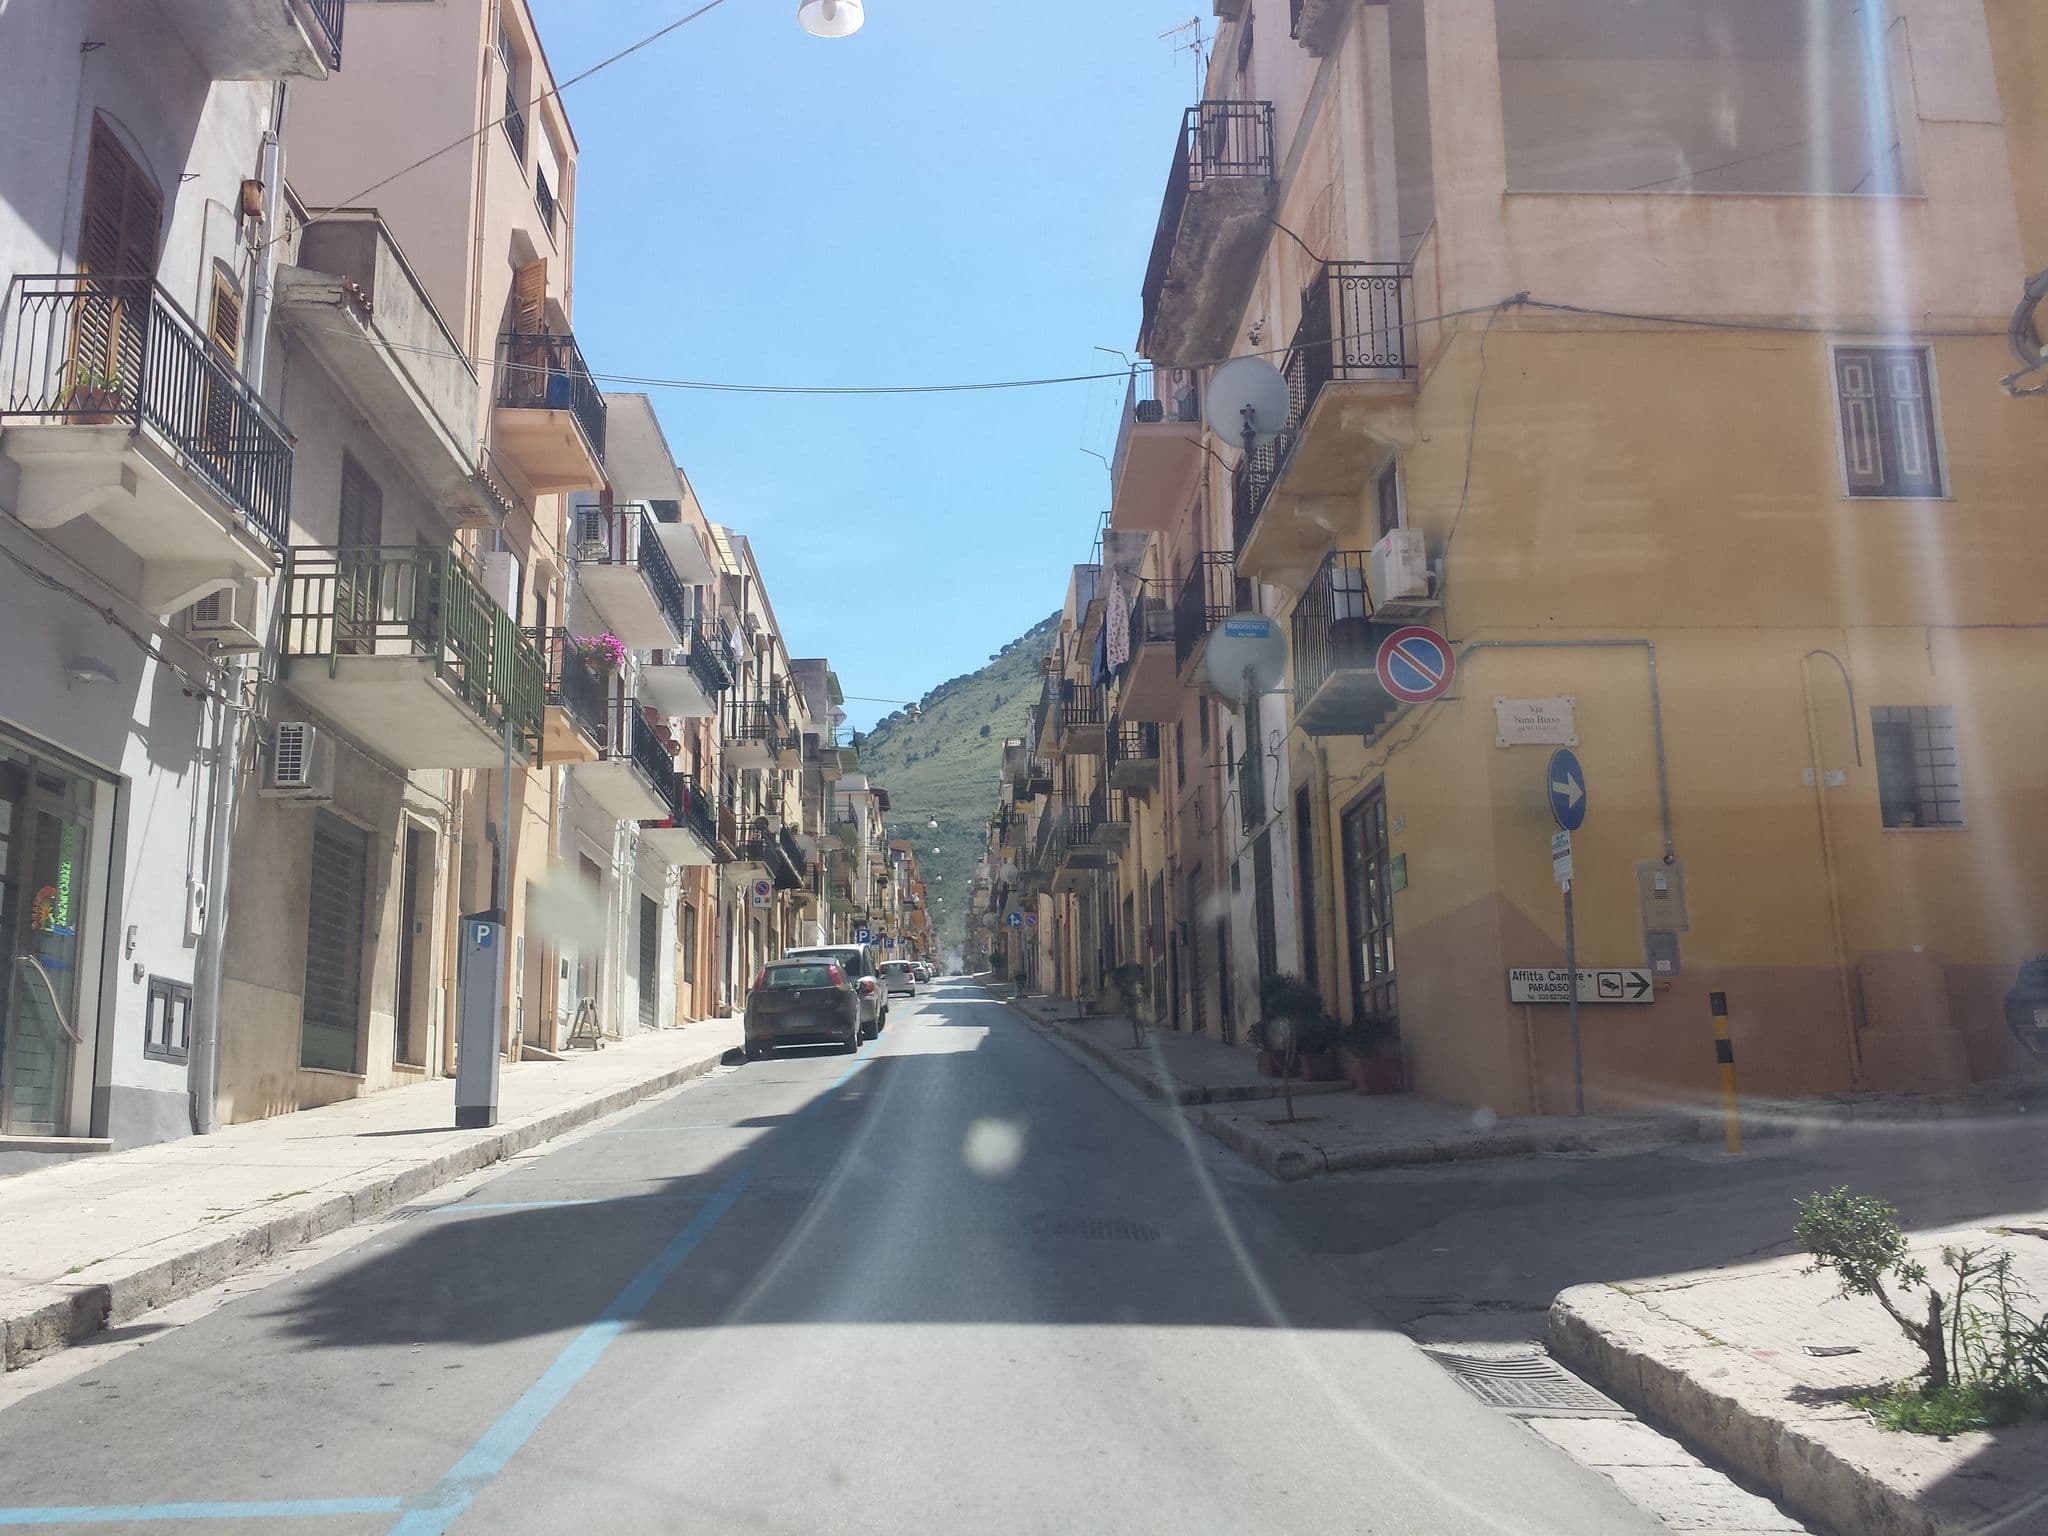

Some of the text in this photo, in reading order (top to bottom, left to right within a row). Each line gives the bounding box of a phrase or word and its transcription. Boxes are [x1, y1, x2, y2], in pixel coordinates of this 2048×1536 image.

[1528, 705, 1543, 713] Via
[1513, 715, 1560, 725] Nino Bixio
[477, 924, 490, 944] P
[859, 930, 868, 942] P
[870, 934, 878, 944] P
[1512, 970, 1544, 981] Affitta
[1528, 983, 1569, 992] PARADISO
